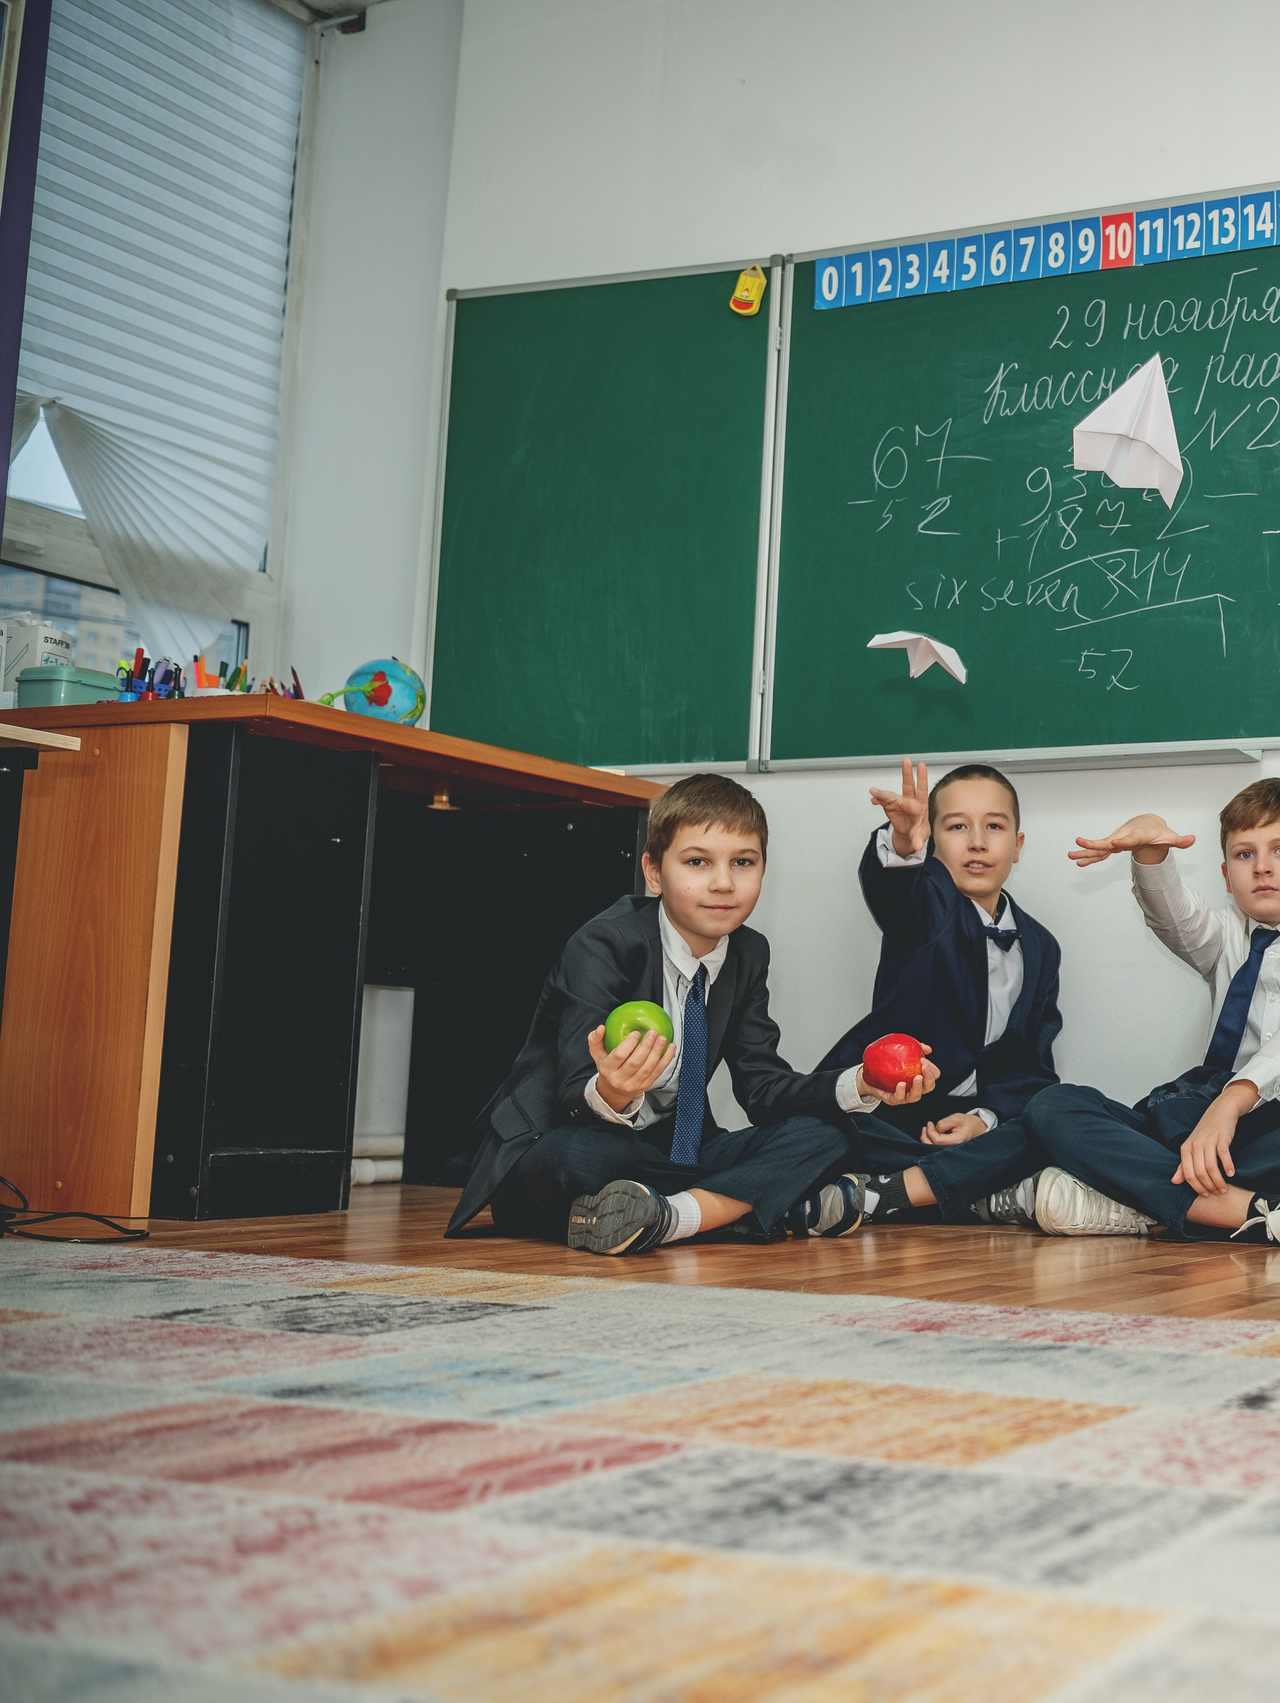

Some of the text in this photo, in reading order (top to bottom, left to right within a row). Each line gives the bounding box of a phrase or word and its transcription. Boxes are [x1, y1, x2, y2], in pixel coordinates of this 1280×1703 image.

[822, 266, 839, 301] 0
[851, 262, 863, 296] 1
[877, 258, 893, 293] 2
[905, 253, 920, 289] 3
[933, 249, 950, 284] 4
[961, 245, 977, 281] 5
[990, 240, 1007, 276] 6
[1019, 236, 1036, 272] 7
[1048, 232, 1066, 268] 8
[1077, 228, 1096, 264] 9
[1104, 222, 1132, 260] 10
[1138, 218, 1165, 256] 11
[1173, 212, 1202, 251] 12
[1207, 207, 1237, 246] 13
[1242, 201, 1274, 241] 14
[1050, 299, 1107, 349] 29
[873, 418, 994, 493] 67
[906, 574, 1093, 621] six seven
